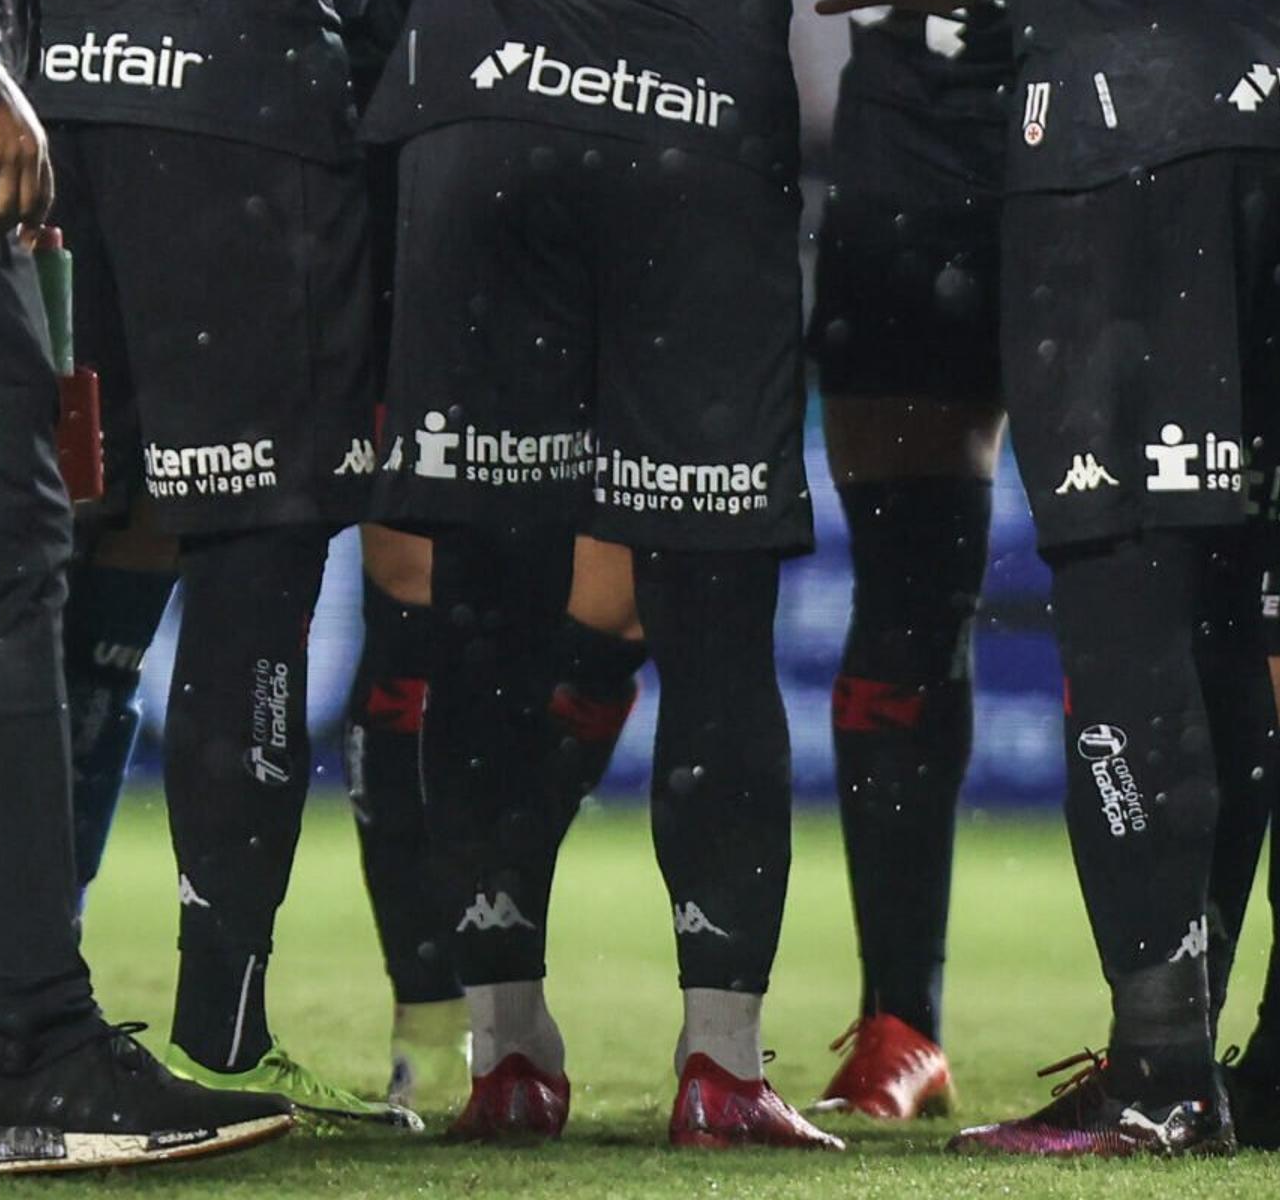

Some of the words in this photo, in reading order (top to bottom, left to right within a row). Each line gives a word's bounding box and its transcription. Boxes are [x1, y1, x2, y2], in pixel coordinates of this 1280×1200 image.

[40, 31, 204, 89] etfair
[527, 45, 736, 128] betfair
[195, 470, 278, 494] viagem
[466, 465, 542, 486] seguro
[612, 449, 769, 493] intermac
[613, 488, 684, 513] seguro
[691, 492, 769, 515] viagem
[1091, 758, 1126, 837] tradição
